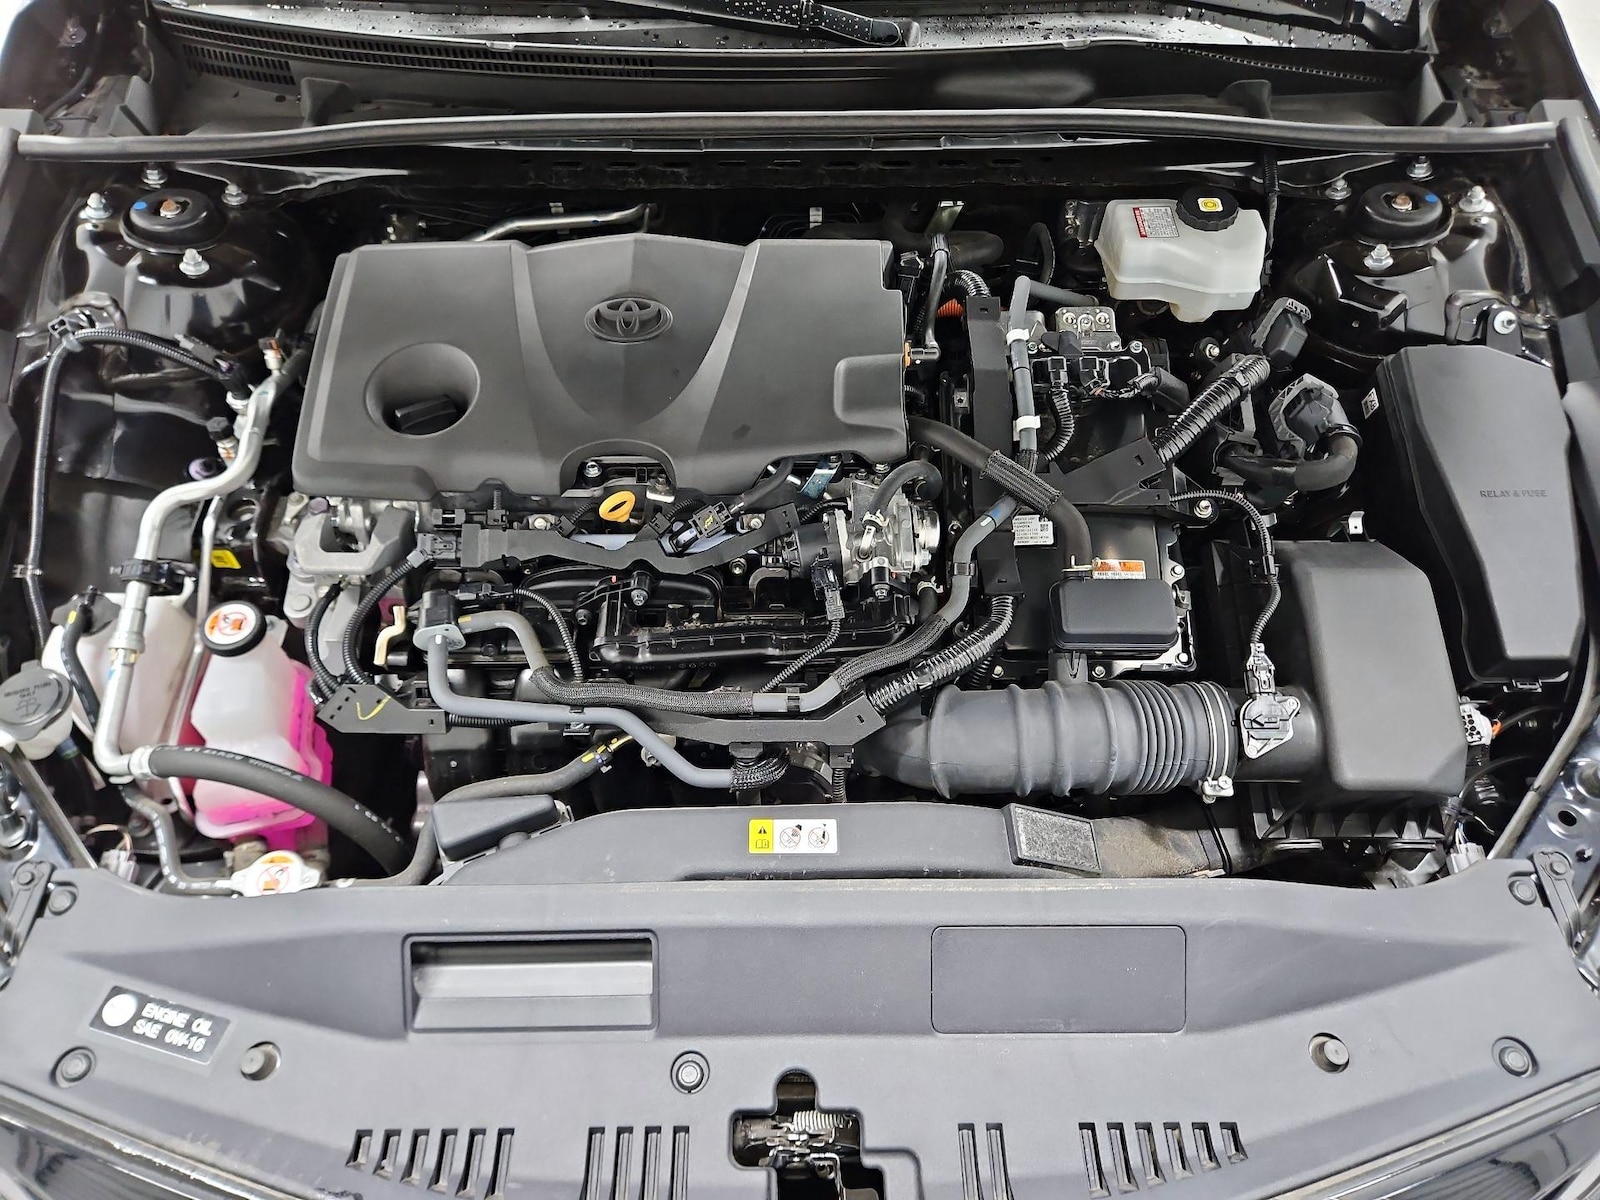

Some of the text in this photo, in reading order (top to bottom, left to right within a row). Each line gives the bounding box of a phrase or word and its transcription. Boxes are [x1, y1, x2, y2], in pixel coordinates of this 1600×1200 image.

[1479, 489, 1548, 498] RELAY & FUSE
[141, 1002, 191, 1028] ENGINE
[132, 1018, 163, 1039] SAE
